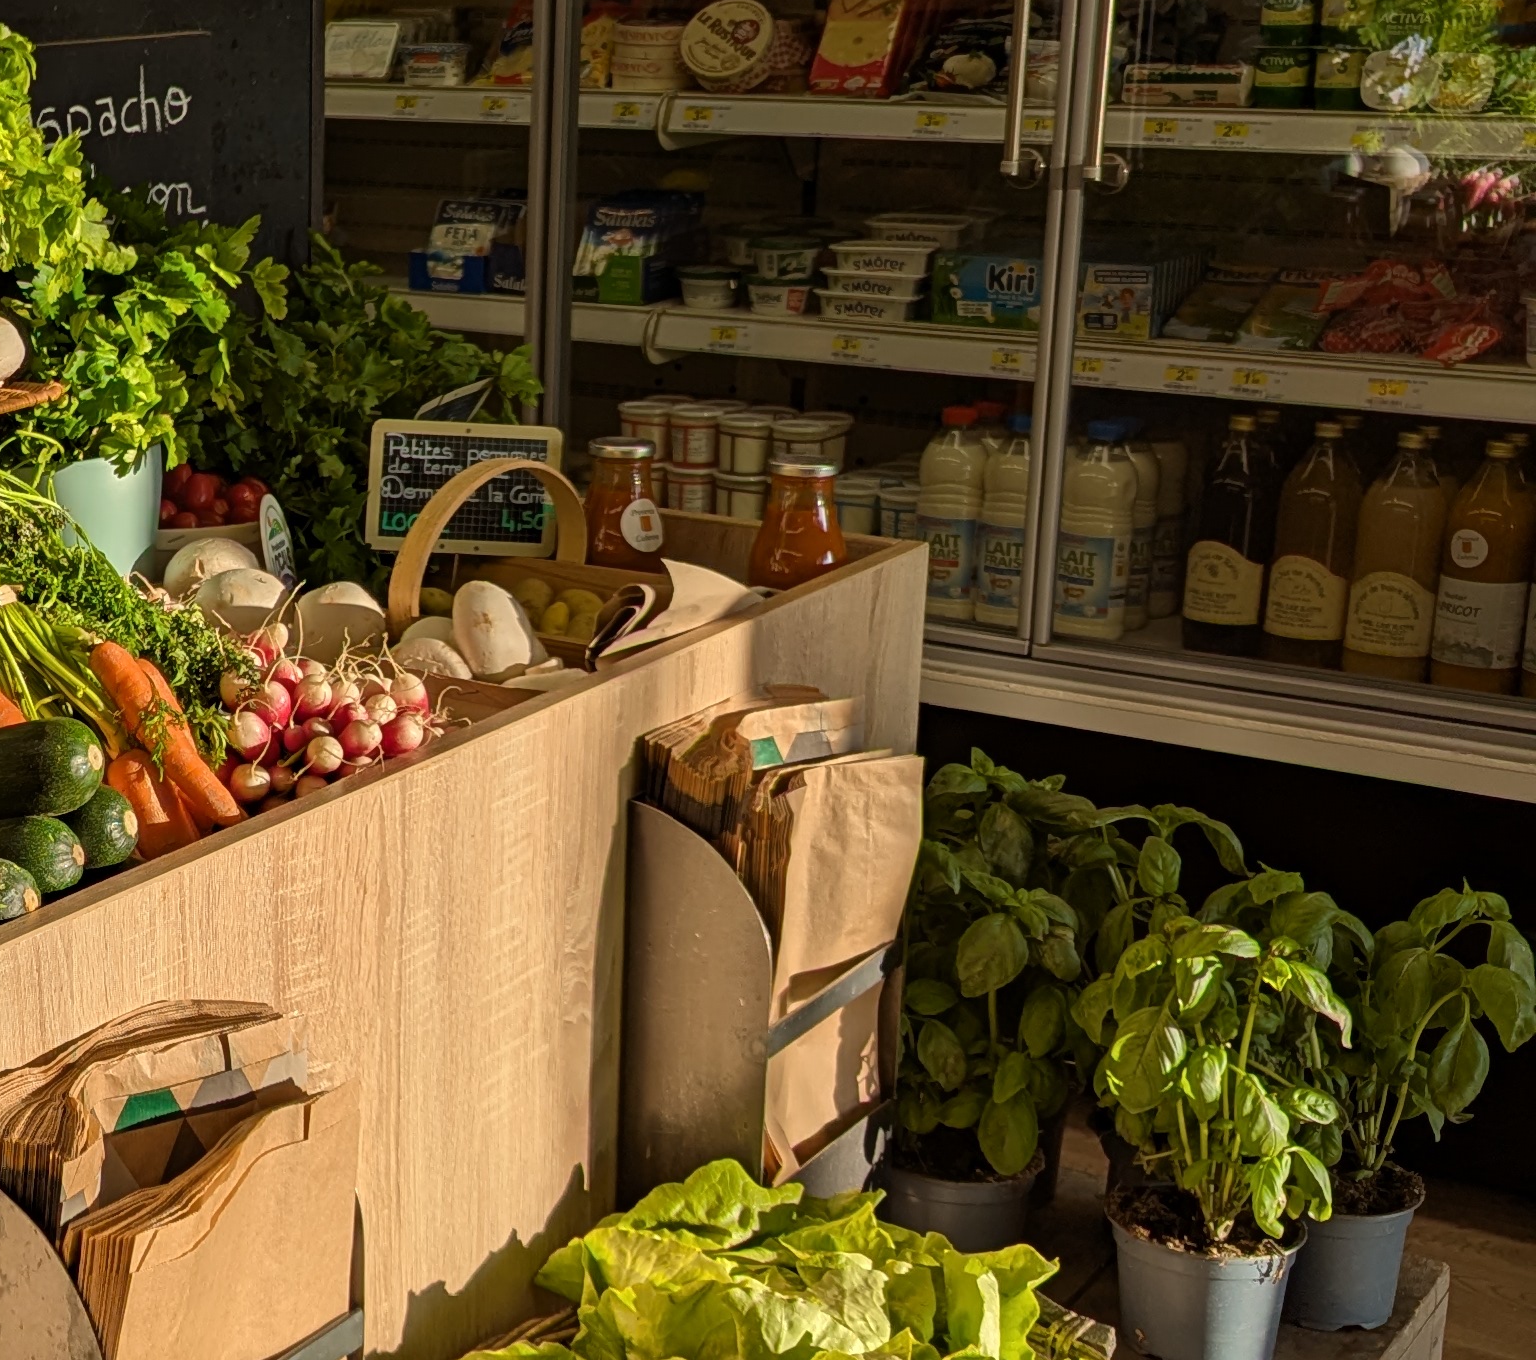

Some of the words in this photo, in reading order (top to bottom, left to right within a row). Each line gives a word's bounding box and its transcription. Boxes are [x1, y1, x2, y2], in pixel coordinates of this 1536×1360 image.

[36, 65, 192, 151] spacho
[988, 264, 1036, 293] Kiri
[386, 432, 454, 459] Petites
[388, 457, 413, 474] de
[929, 547, 960, 559] RAIS
